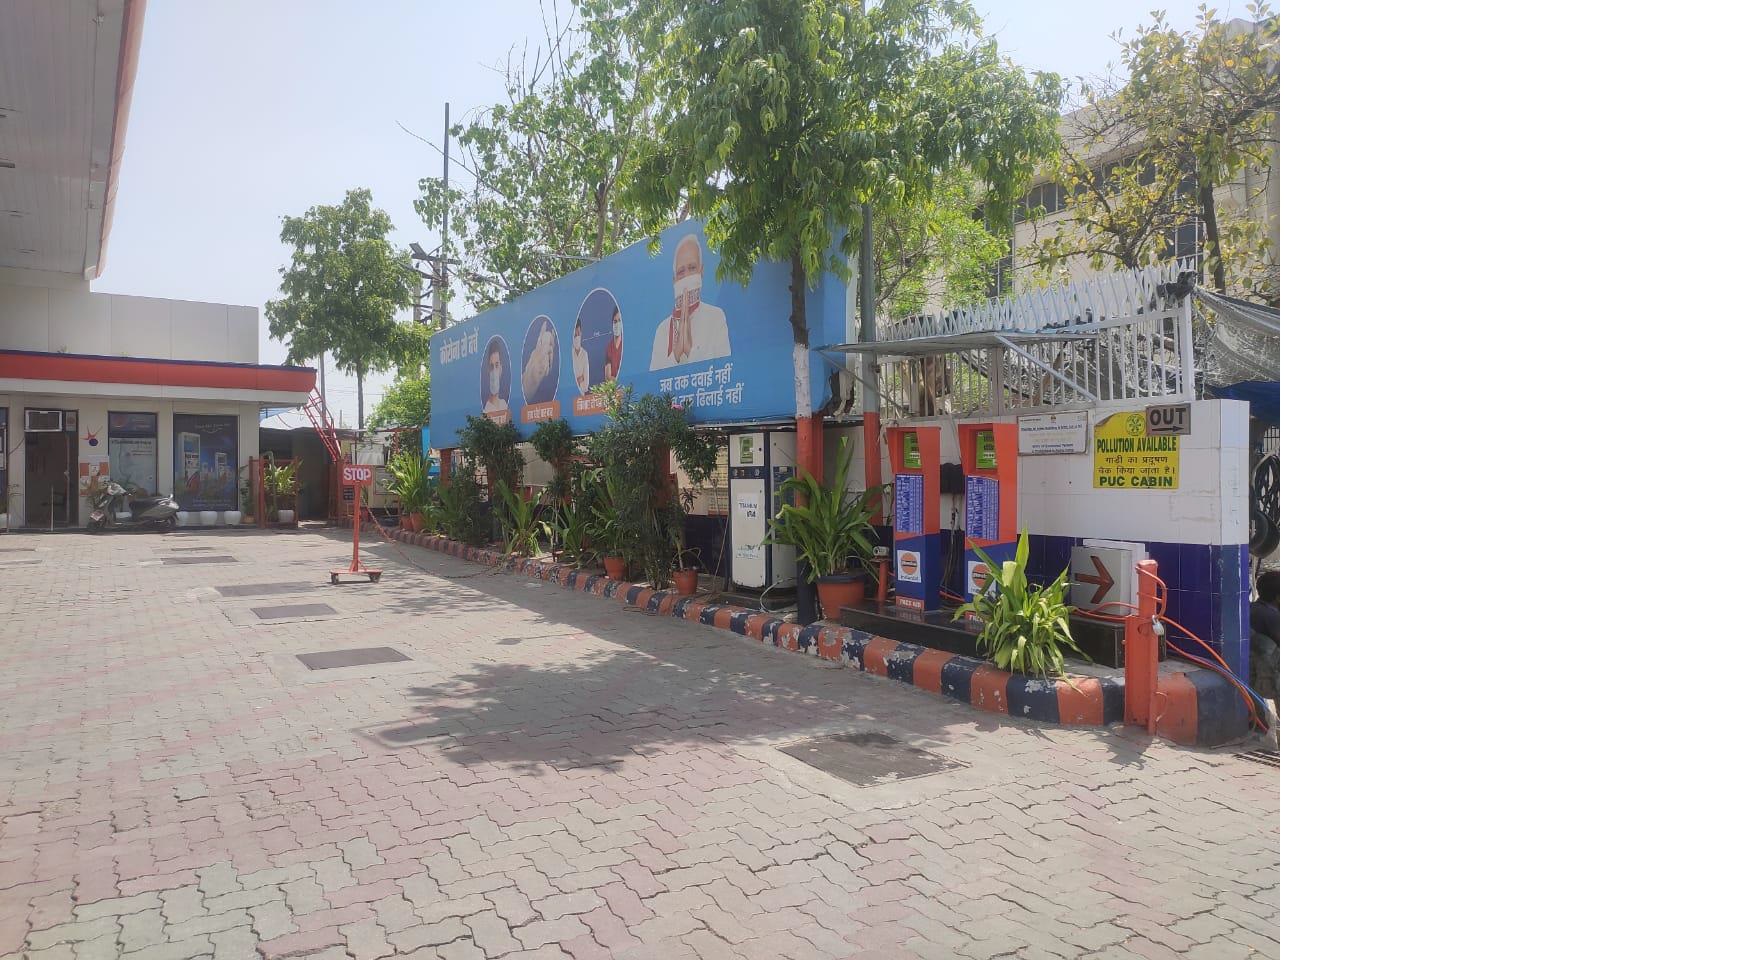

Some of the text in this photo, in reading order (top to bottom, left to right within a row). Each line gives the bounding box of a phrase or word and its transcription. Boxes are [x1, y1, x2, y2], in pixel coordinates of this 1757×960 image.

[440, 337, 460, 364] कोरोना
[659, 362, 734, 392] जब तक दवाई नहीं
[696, 385, 724, 408] ढिलाई
[725, 382, 744, 404] नहीं
[1149, 407, 1186, 425] OUT
[1097, 436, 1176, 453] POLLUTION AVAILABLE
[1142, 456, 1168, 466] प्रदूषण
[343, 467, 371, 481] STOP
[1116, 465, 1135, 475] किया
[1140, 467, 1160, 475] जाता
[1100, 476, 1173, 486] PUC CABIN
